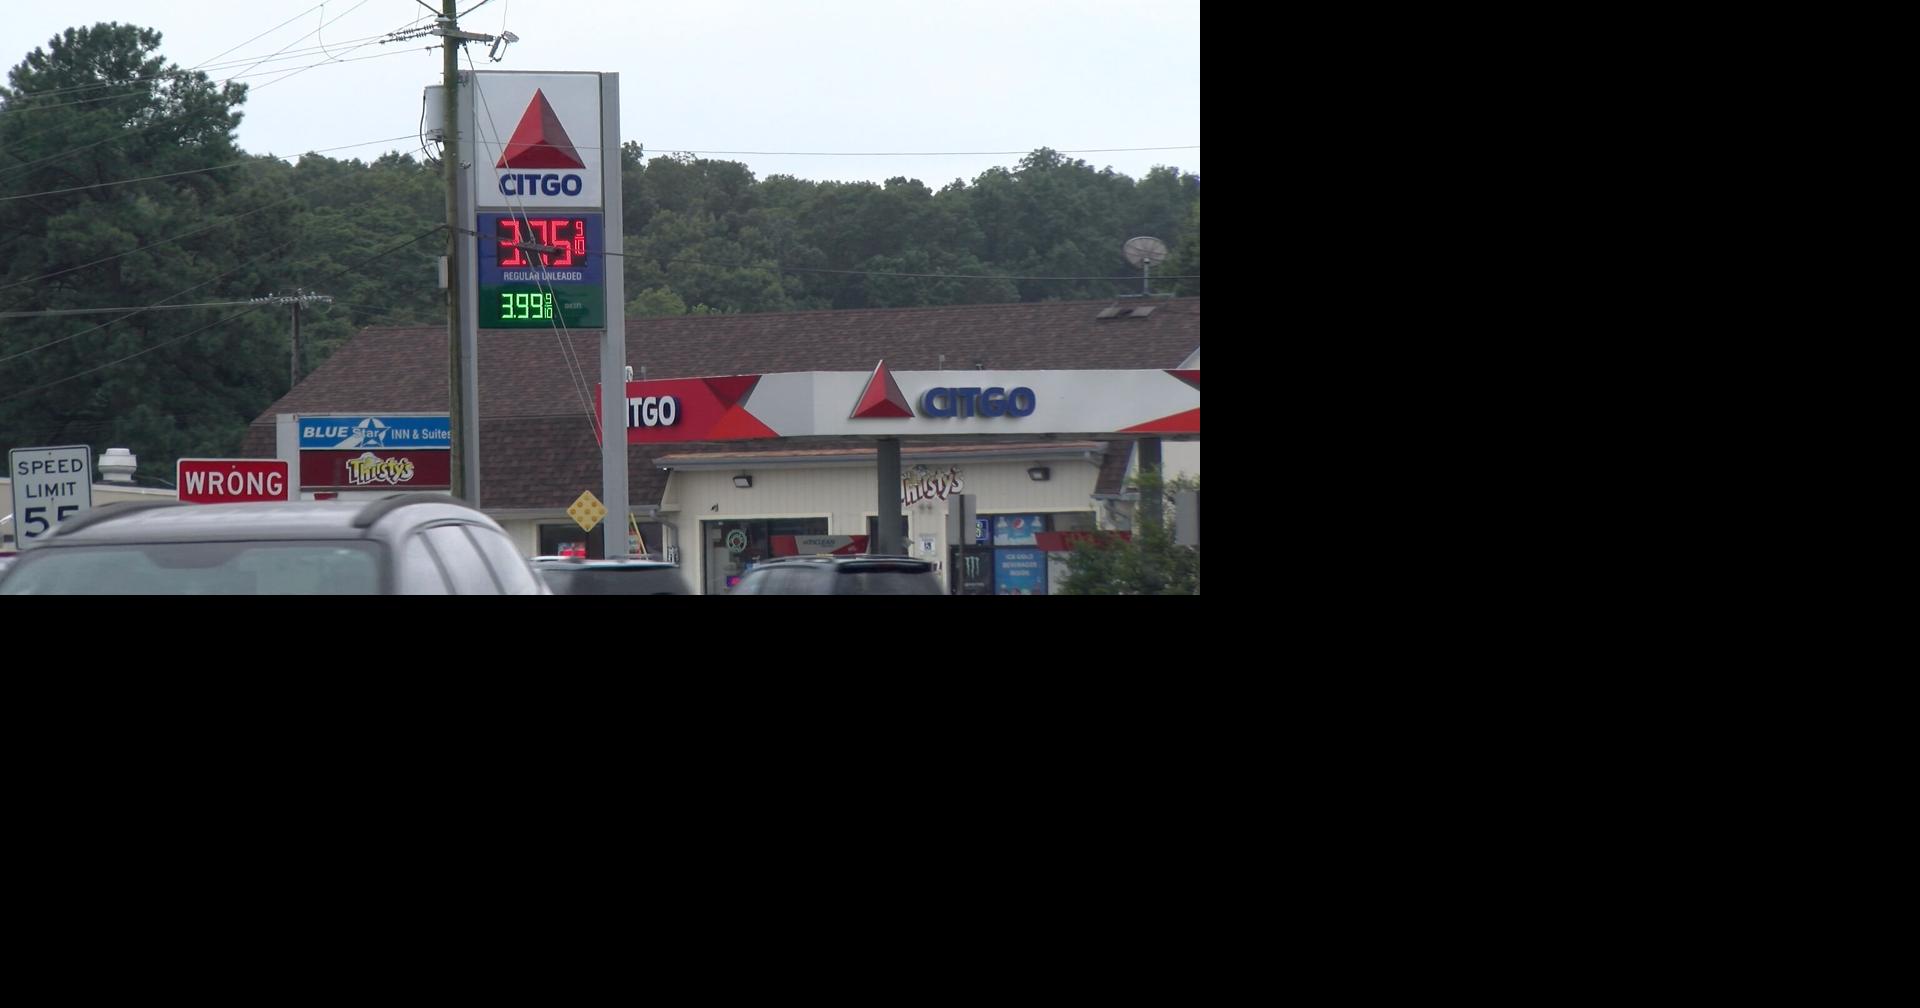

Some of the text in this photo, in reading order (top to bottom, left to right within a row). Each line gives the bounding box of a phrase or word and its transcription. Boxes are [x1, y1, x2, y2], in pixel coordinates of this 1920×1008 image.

[499, 173, 582, 196] CITGO
[503, 271, 582, 281] REGULAR UNLEADED
[502, 293, 543, 319] 3.99
[625, 395, 676, 428] ITGO
[923, 386, 1036, 418] CITGO
[303, 426, 349, 438] BLUE
[352, 428, 379, 438] Star
[391, 429, 410, 440] INN
[412, 430, 420, 440] &
[17, 458, 83, 476] SPEED
[25, 481, 77, 499] LIMIT
[185, 471, 283, 496] WRONG
